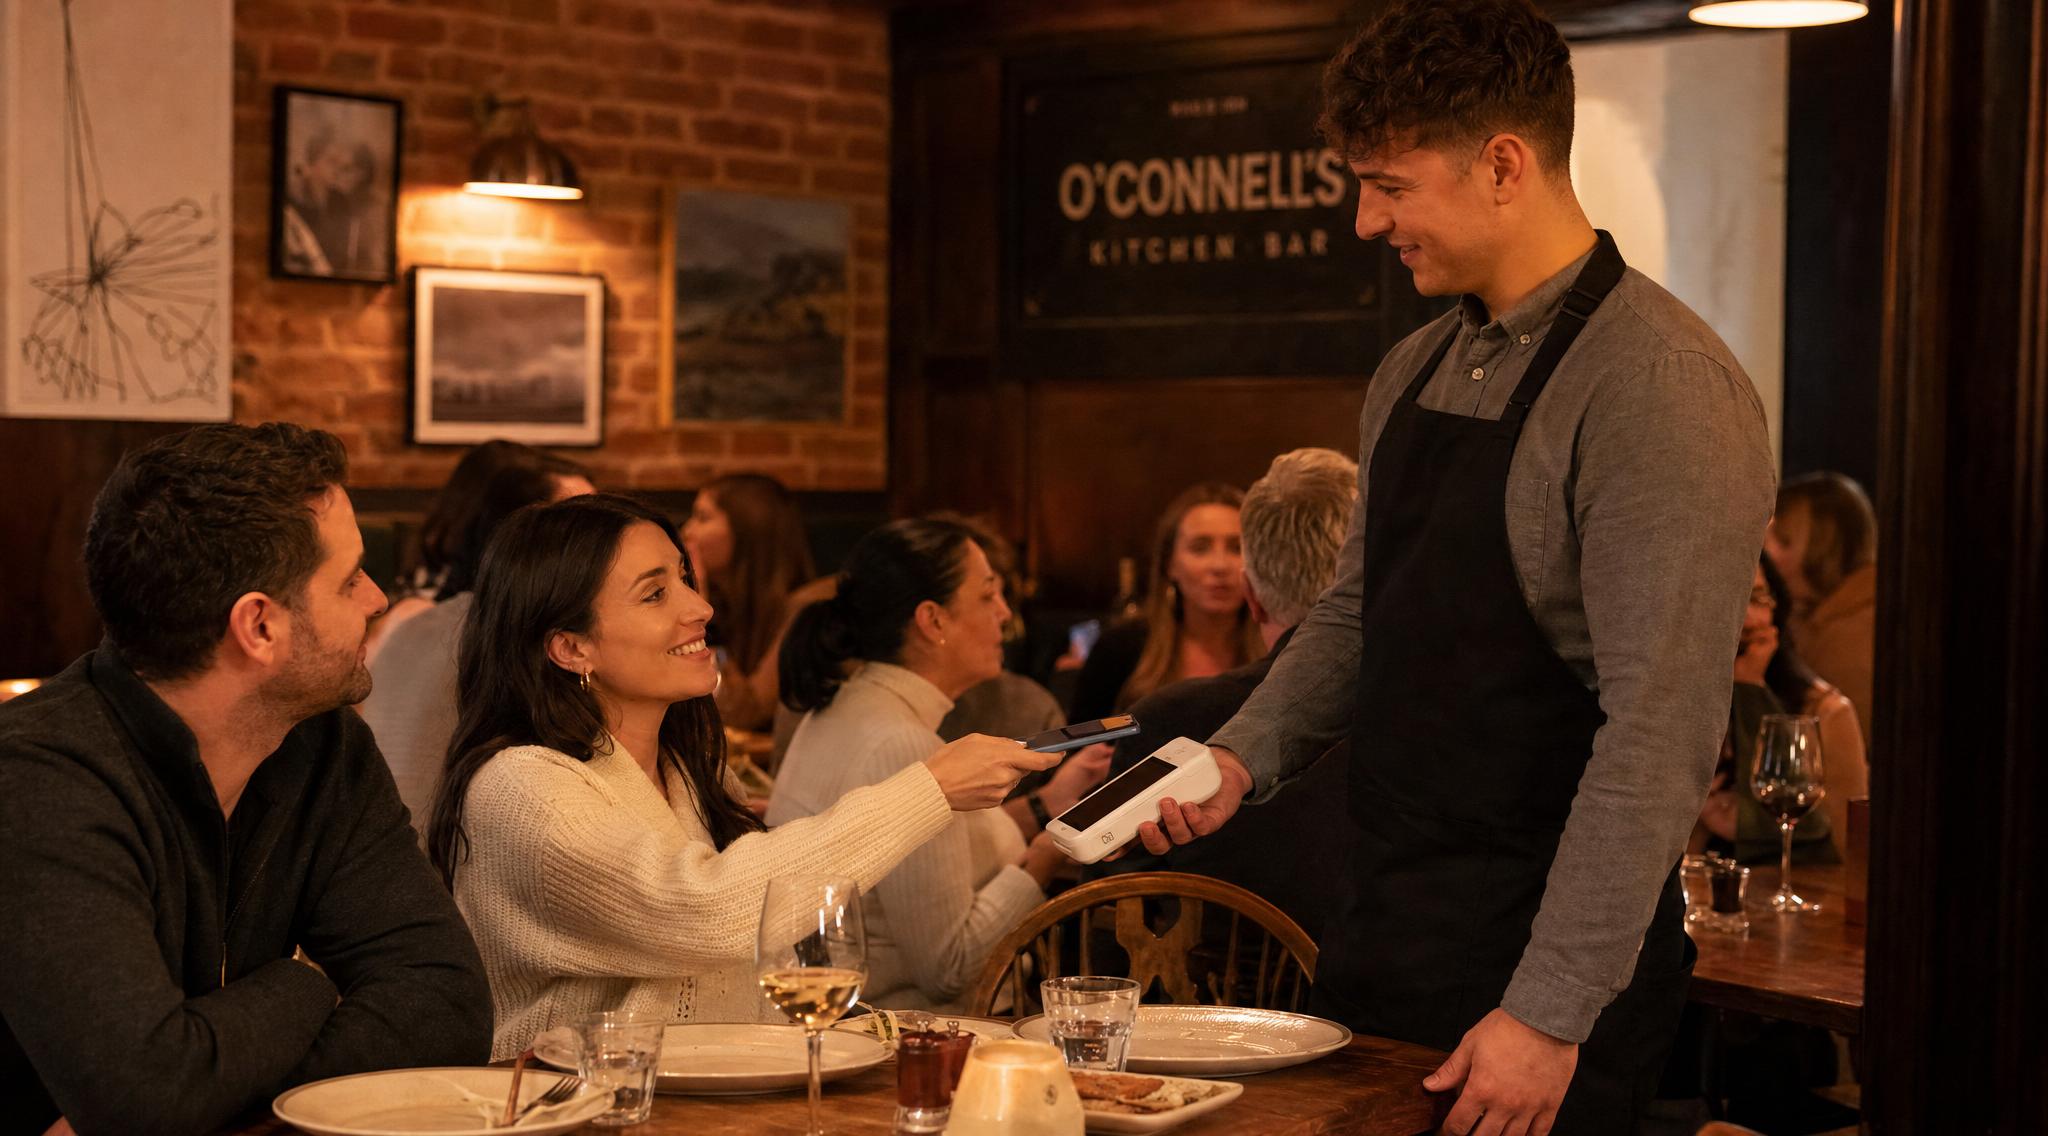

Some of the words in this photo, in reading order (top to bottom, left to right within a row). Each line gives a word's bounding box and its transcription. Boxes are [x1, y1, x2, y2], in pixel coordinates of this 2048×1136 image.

[1059, 148, 1346, 221] O'CONNELL'S
[1089, 235, 1235, 266] KITCHEN
[1264, 229, 1328, 259] BAR
